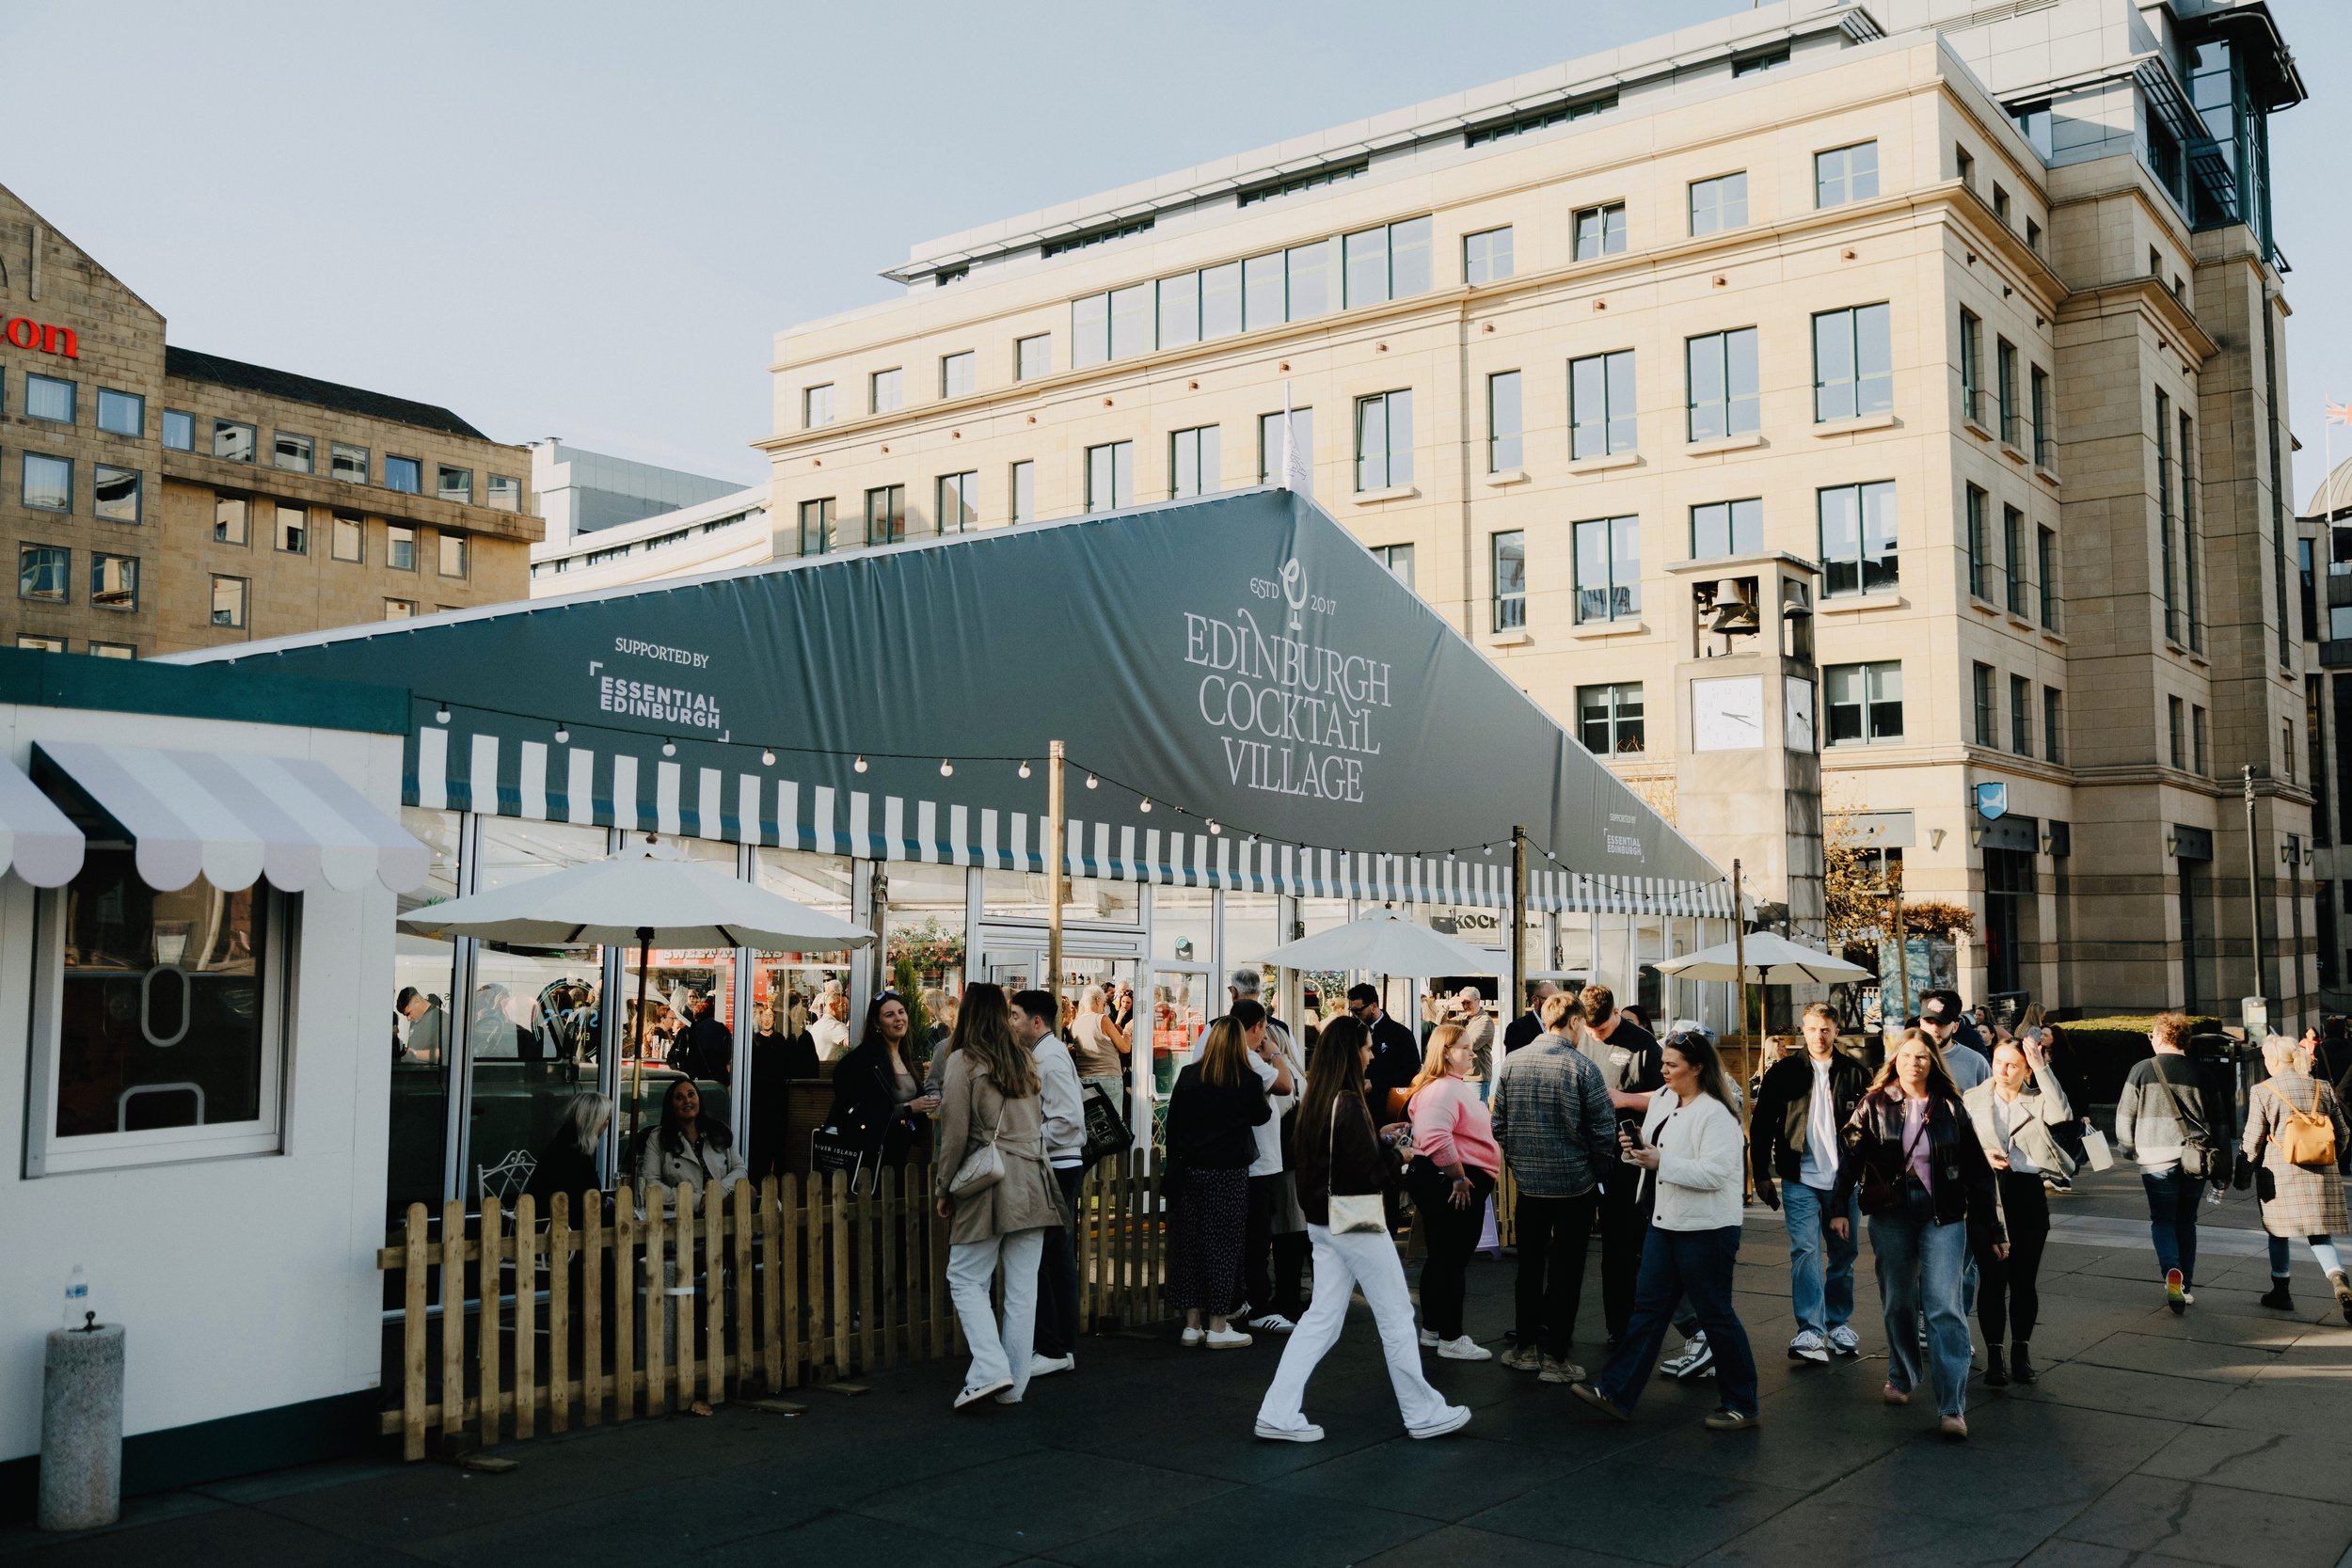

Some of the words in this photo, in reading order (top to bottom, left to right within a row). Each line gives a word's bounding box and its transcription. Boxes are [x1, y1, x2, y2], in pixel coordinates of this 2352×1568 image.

[0, 312, 78, 359] on
[1250, 577, 1279, 599] ESTD
[1311, 594, 1337, 615] 2017
[615, 637, 691, 665] SUPPORTED
[692, 653, 709, 669] BY
[1184, 608, 1391, 717] EDINBURGH
[600, 675, 721, 714] ESSENTIAL
[600, 693, 721, 730] EDINBURGH
[1200, 674, 1381, 754] COCKTAIL
[1221, 736, 1364, 803] VILLAGE
[1607, 834, 1641, 847] ESSENTIAL
[1607, 844, 1642, 856] EDINBURGH
[814, 1143, 833, 1152] RIVER
[834, 1147, 858, 1157] ISLAND
